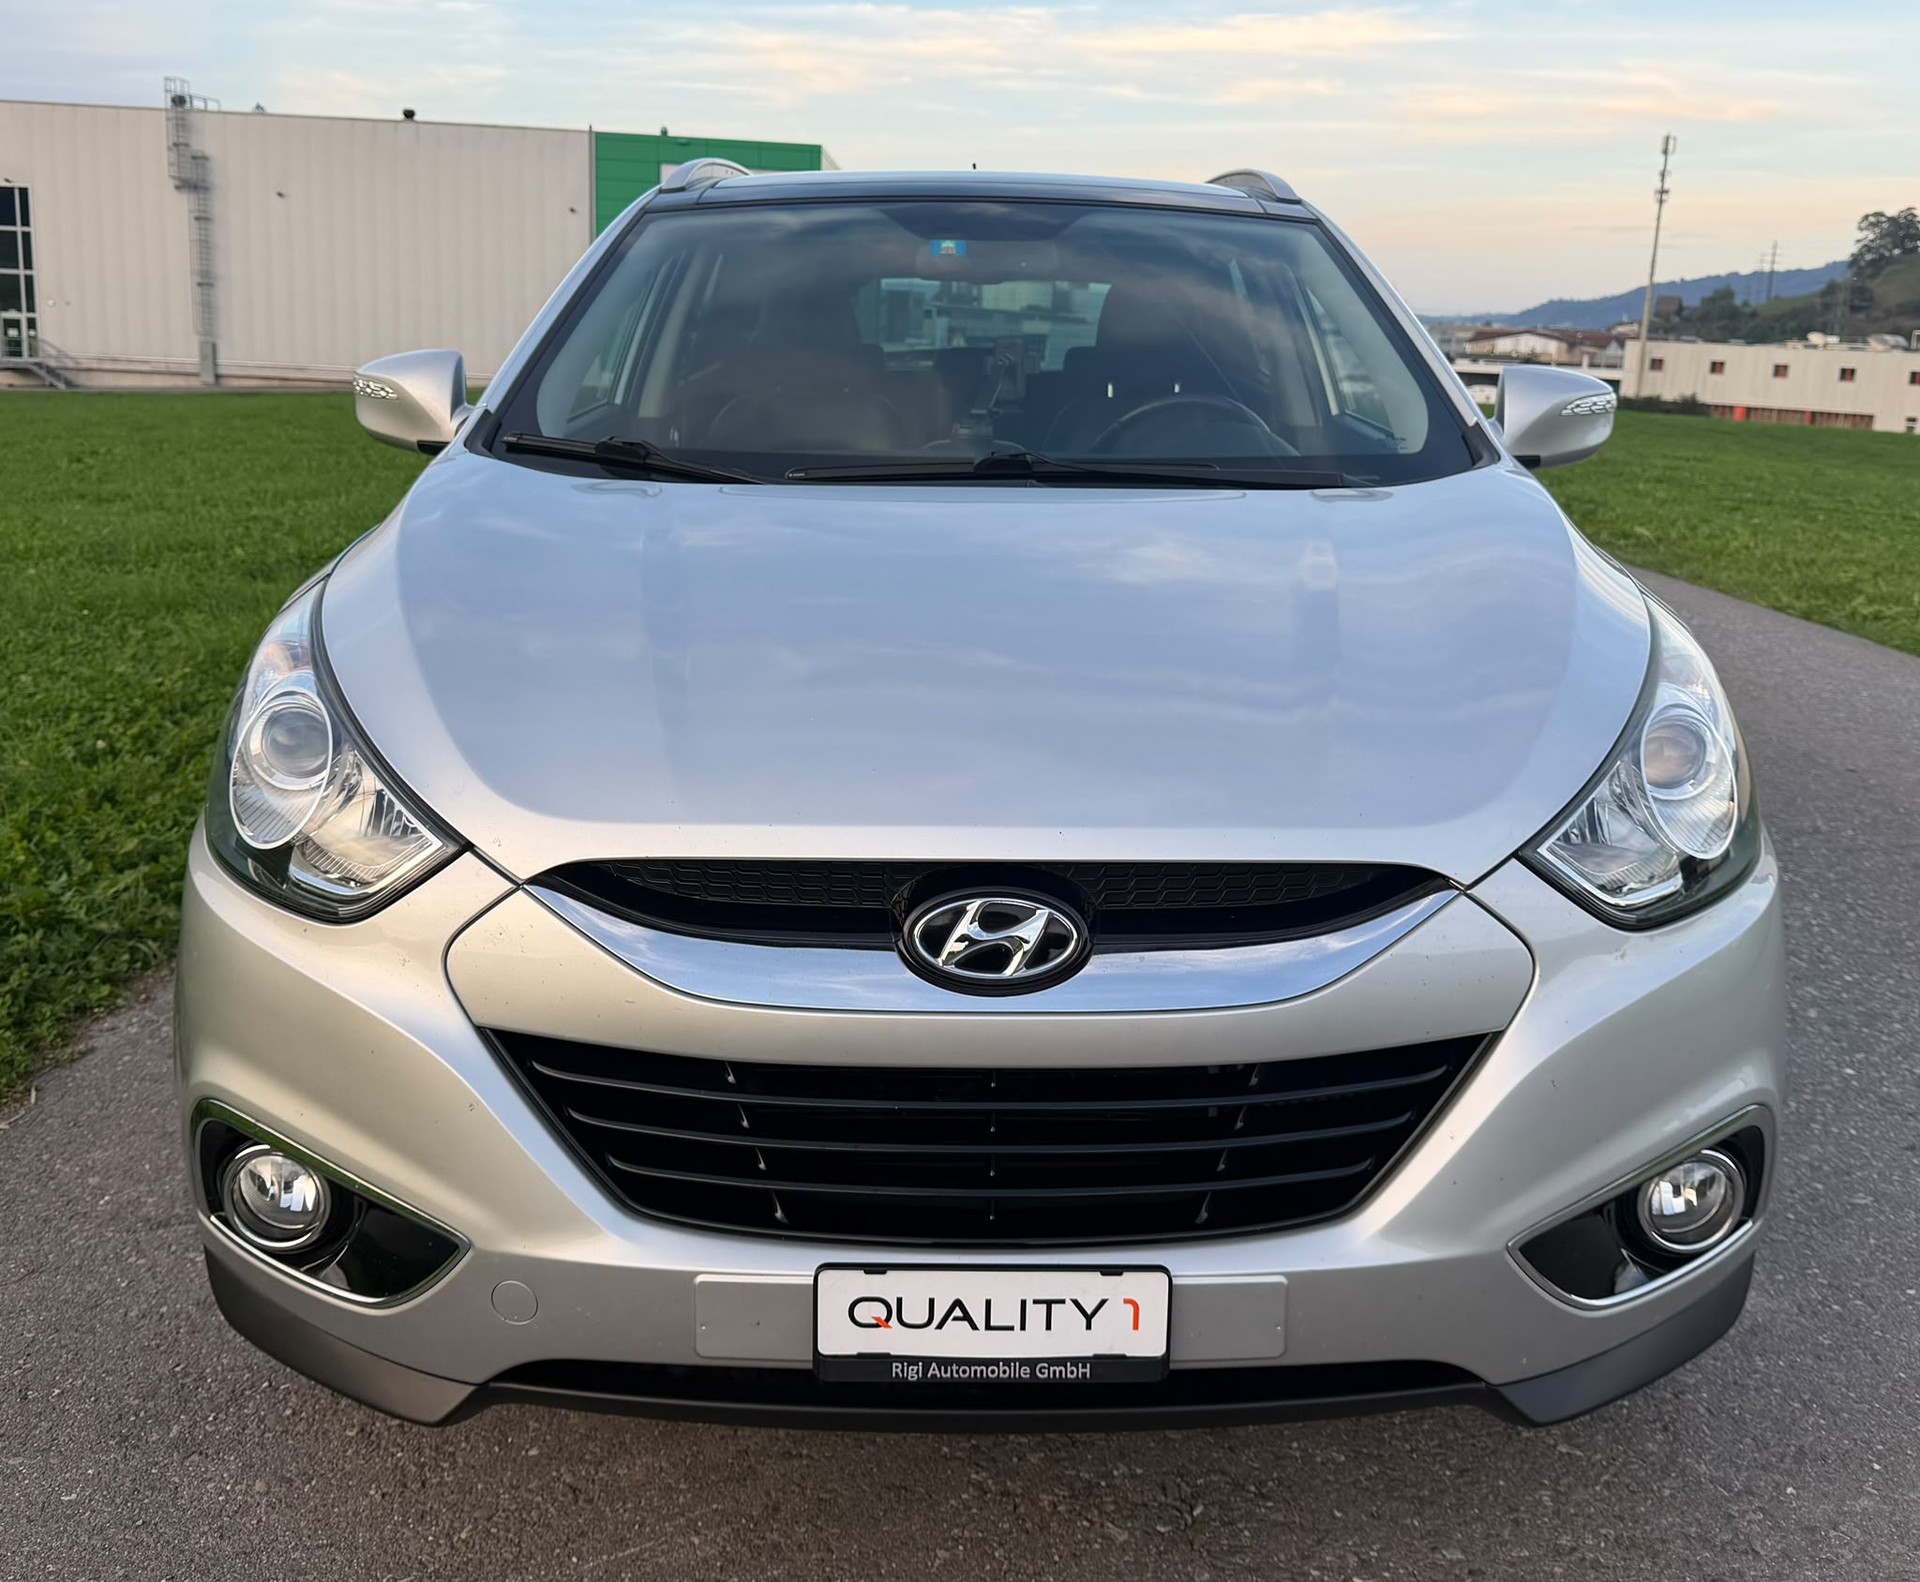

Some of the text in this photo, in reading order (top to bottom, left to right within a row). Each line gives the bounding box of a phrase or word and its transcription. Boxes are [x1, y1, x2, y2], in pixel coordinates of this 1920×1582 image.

[848, 1296, 1109, 1331] QUALITY
[892, 1362, 1091, 1380] Rigi Automobile GmbH
